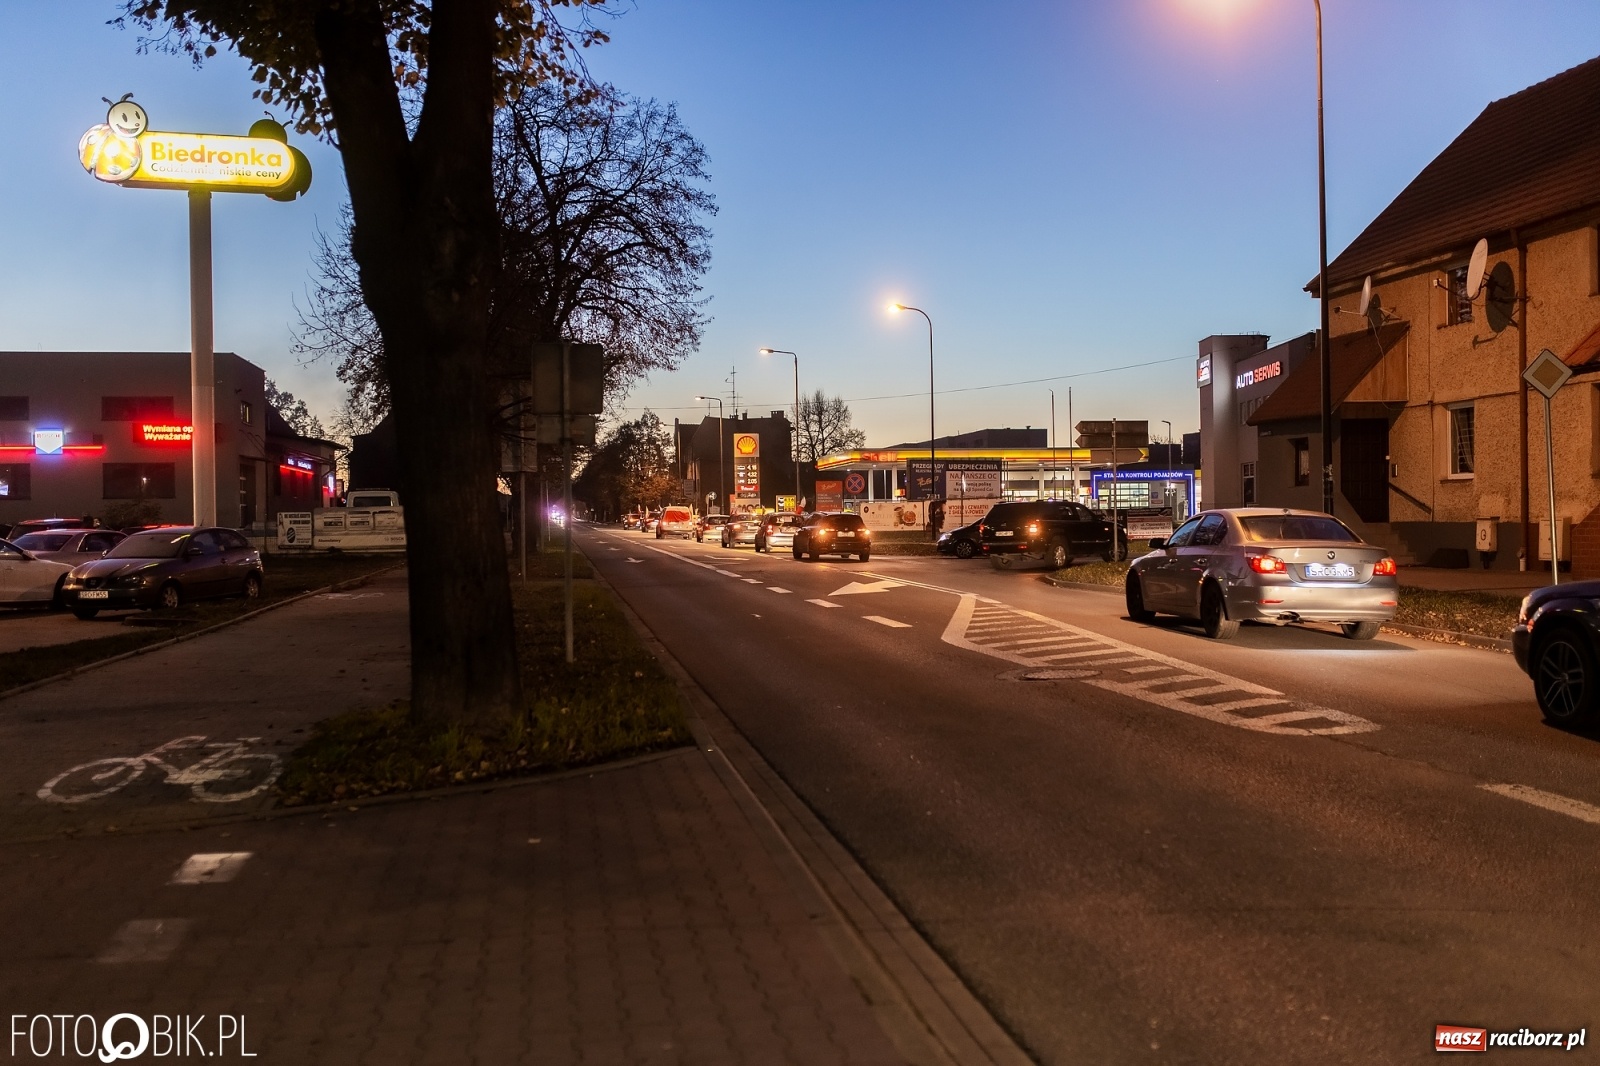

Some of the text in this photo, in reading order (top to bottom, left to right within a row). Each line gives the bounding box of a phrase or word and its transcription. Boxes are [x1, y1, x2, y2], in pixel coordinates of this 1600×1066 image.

[151, 141, 282, 167] Biedronka
[219, 165, 252, 177] niskie
[255, 169, 282, 179] ceny
[1236, 360, 1281, 390] AUTO SERWIS
